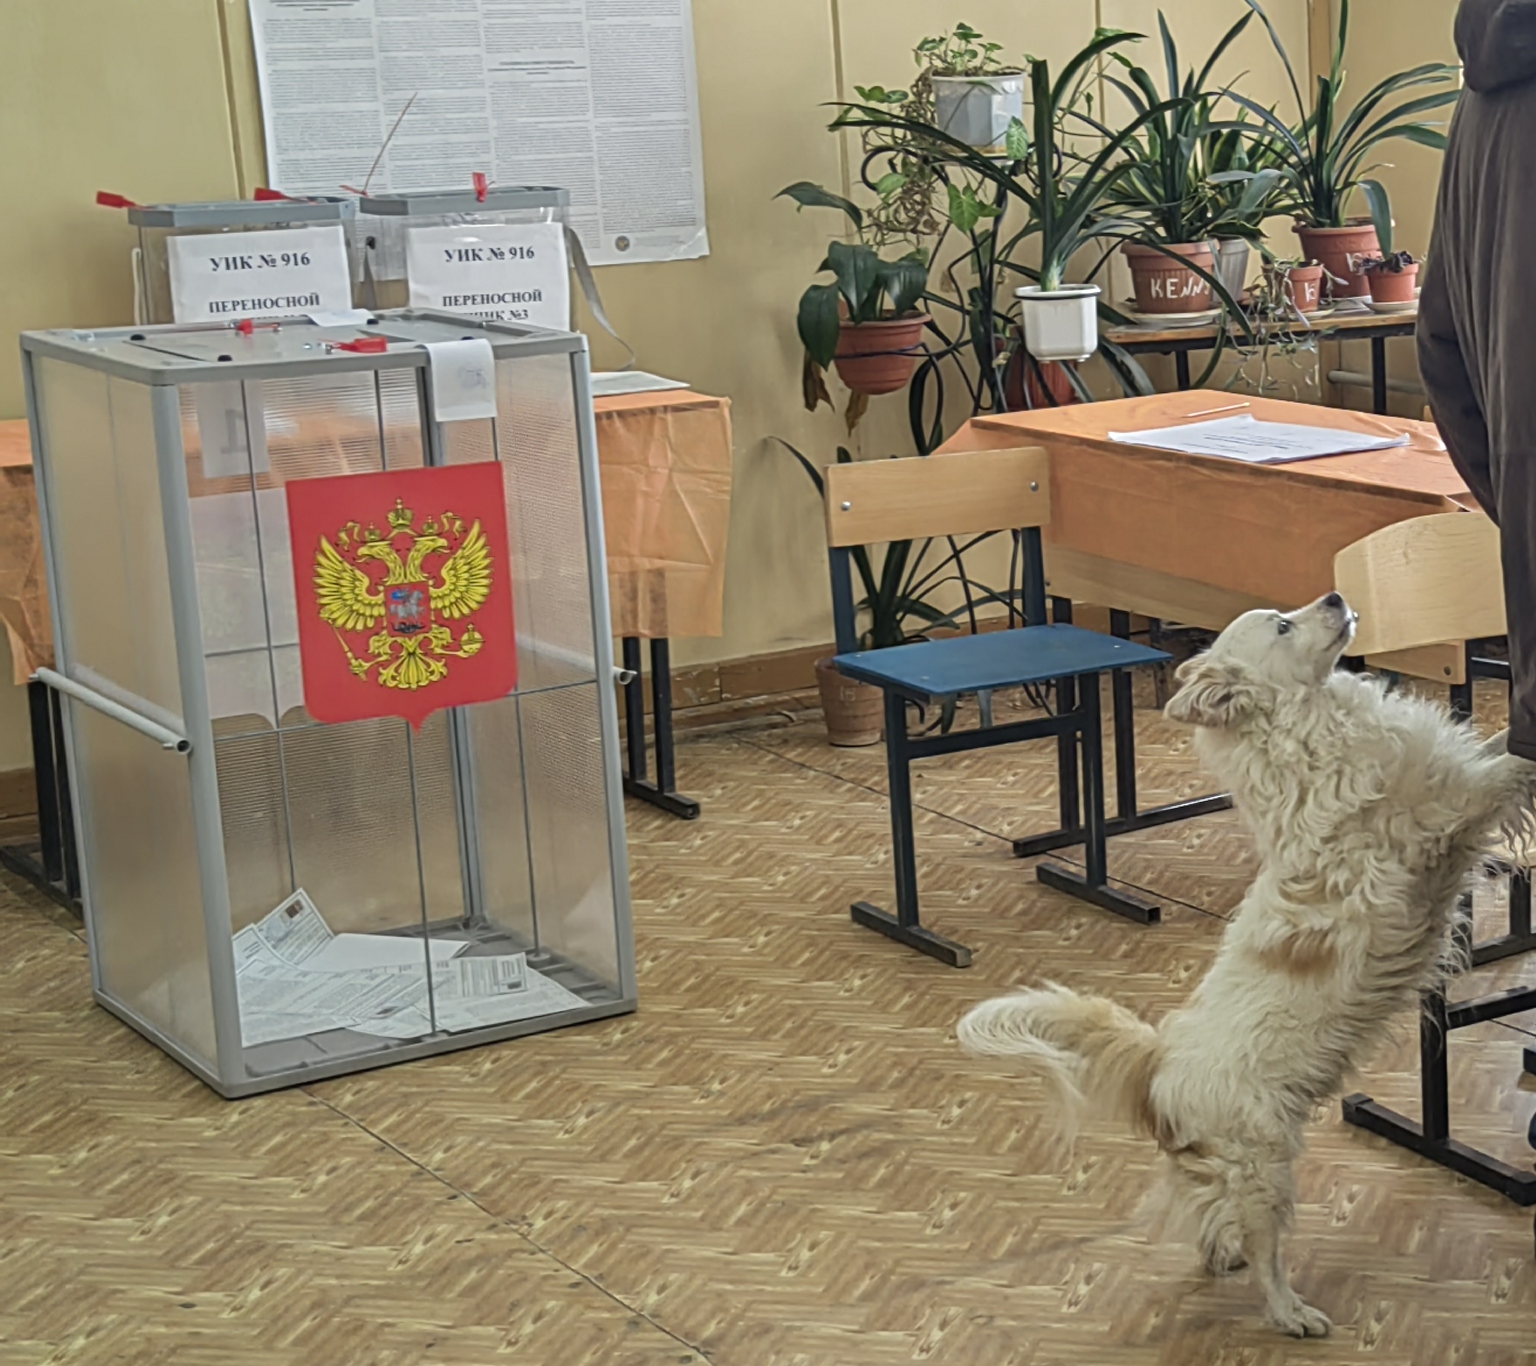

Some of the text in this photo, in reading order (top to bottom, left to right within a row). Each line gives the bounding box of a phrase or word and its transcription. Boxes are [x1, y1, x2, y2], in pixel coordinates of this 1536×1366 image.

[209, 251, 311, 272] УИК № 916
[444, 245, 535, 262] УИК № 916
[209, 291, 320, 314] ПЕРЕНОСНОЙ
[442, 288, 542, 307] ПЕРЕНОСНОЙ
